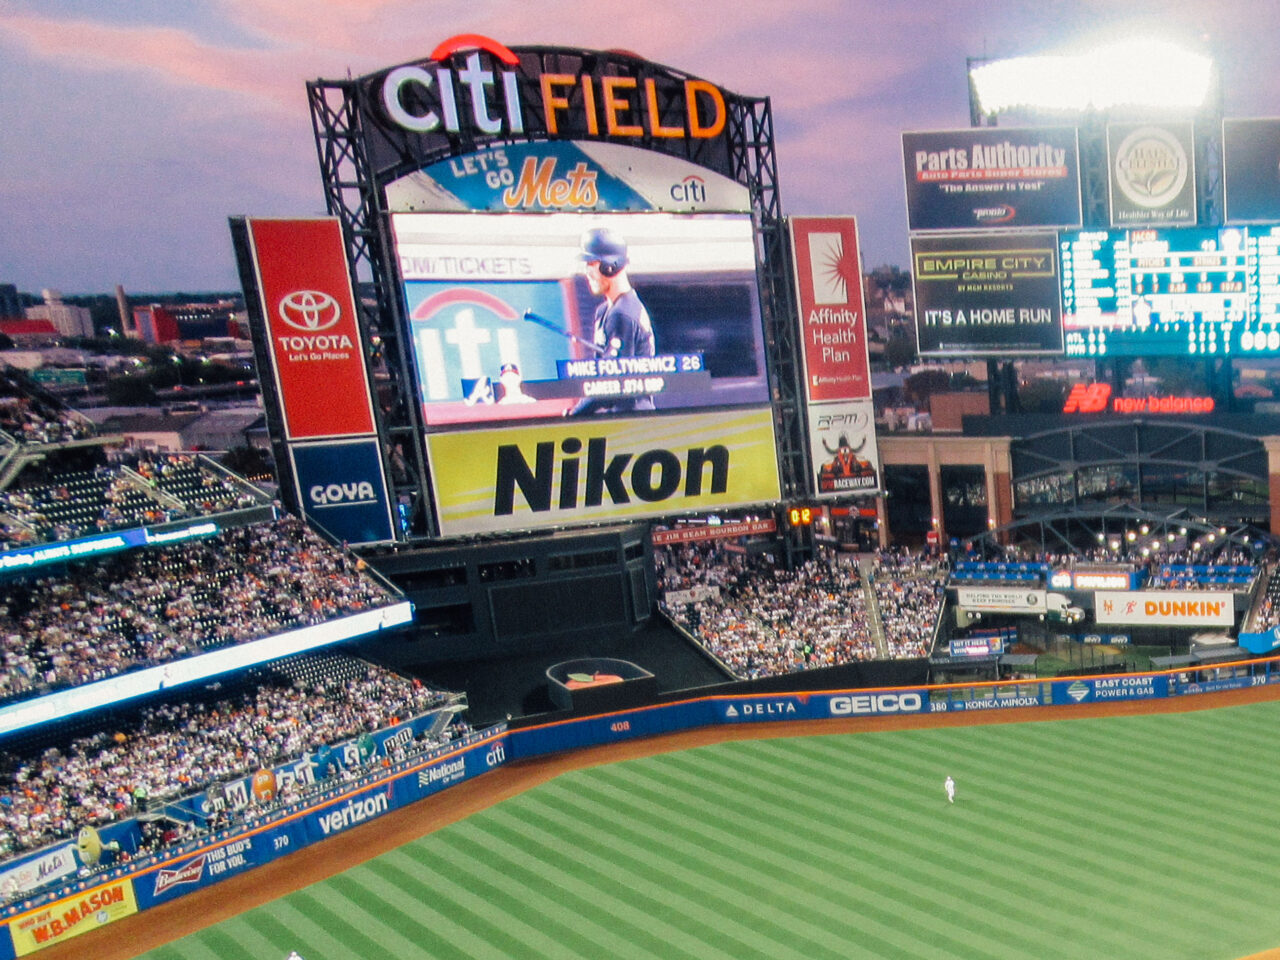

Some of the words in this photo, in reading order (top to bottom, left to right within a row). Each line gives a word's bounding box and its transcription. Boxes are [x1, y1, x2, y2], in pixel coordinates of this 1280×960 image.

[383, 50, 523, 134] citi
[539, 74, 727, 139] FIELD
[450, 151, 509, 178] LET'S
[916, 148, 968, 172] Parts
[972, 141, 1066, 171] Authority
[486, 168, 514, 190] GO
[504, 156, 599, 208] Mets
[922, 170, 948, 180] Auto
[952, 170, 983, 179] Parts
[670, 179, 707, 202] citi
[965, 182, 1004, 192] Answer
[923, 258, 997, 271] EMPIRE
[1001, 256, 1045, 269] CITY
[962, 271, 1007, 280] CASINO
[809, 308, 858, 328] Affinity
[925, 309, 952, 325] IT'S
[956, 309, 967, 325] A
[970, 308, 1016, 325] HOME
[1020, 308, 1052, 323] RUN
[278, 334, 353, 351] TOYOTA
[813, 327, 856, 345] Health
[289, 353, 309, 361] Let's
[310, 353, 322, 361] Go
[323, 351, 349, 360] Places
[822, 346, 850, 363] Plan
[567, 360, 596, 377] MIKE
[682, 357, 701, 371] 26
[1113, 397, 1146, 412] new
[1148, 395, 1215, 413] balance
[818, 413, 858, 430] RPM
[493, 436, 730, 517] Nikon
[310, 481, 375, 504] GOYA
[683, 530, 707, 539] BEAM
[709, 526, 748, 536] BOURBON
[752, 523, 769, 531] BAR
[1145, 601, 1220, 617] DUNKIN'
[1095, 679, 1119, 689] EAST
[1123, 677, 1154, 687] COAST
[1252, 675, 1266, 686] 370
[1095, 688, 1126, 698] POWER
[1128, 687, 1134, 697] &
[1136, 686, 1154, 696] GAS
[744, 702, 796, 715] DELTA
[830, 693, 922, 715] GEICO
[930, 702, 947, 712] 380
[965, 698, 999, 710] KONICA
[1001, 696, 1039, 707] MINOLTA
[610, 721, 630, 732] 408
[486, 745, 506, 766] citi
[430, 756, 465, 782] National
[319, 792, 388, 834] verizon
[206, 844, 225, 863] THIS
[226, 838, 252, 859] BUD'S
[273, 834, 289, 850] 370
[208, 860, 227, 876] FOR
[228, 855, 247, 872] YOU.
